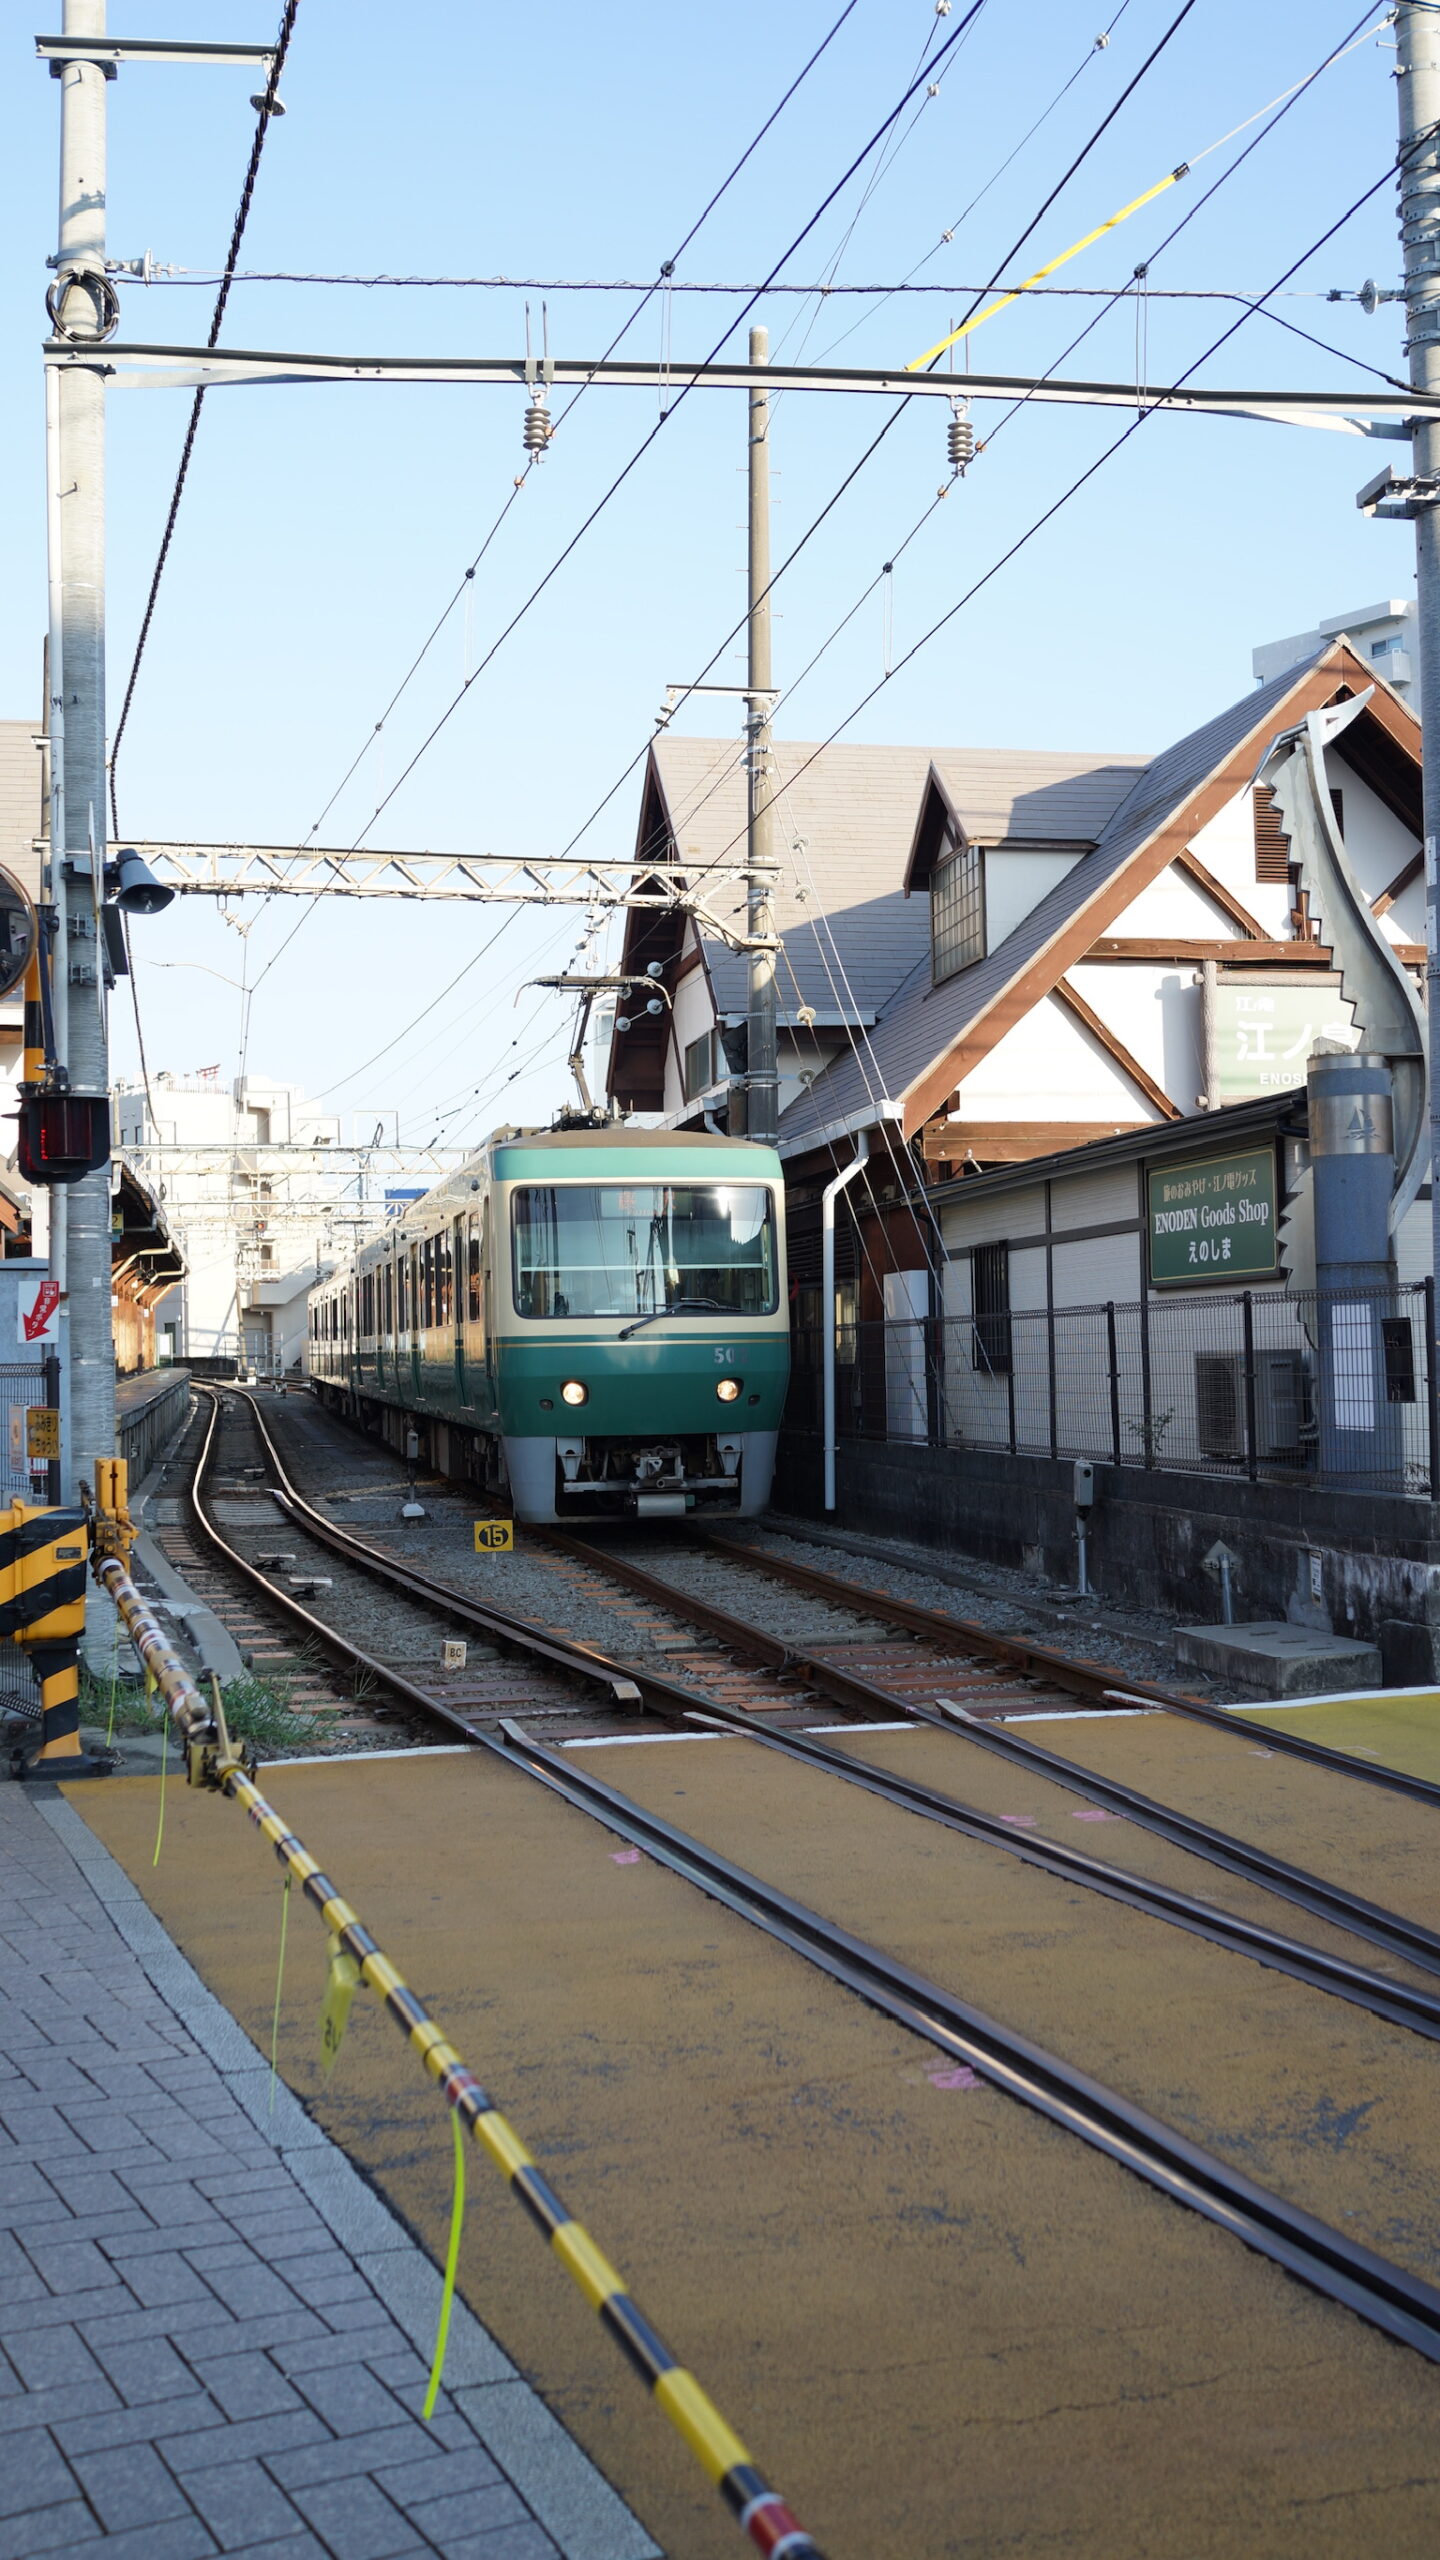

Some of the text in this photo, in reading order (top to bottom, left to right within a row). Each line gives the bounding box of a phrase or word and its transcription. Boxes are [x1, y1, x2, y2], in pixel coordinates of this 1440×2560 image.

[1259, 1072, 1307, 1085] ENOS
[1154, 1198, 1269, 1235] ENODEN Goods Shop
[1188, 1236, 1232, 1264] えのしま
[714, 1347, 750, 1364] 50
[484, 1527, 504, 1546] 15
